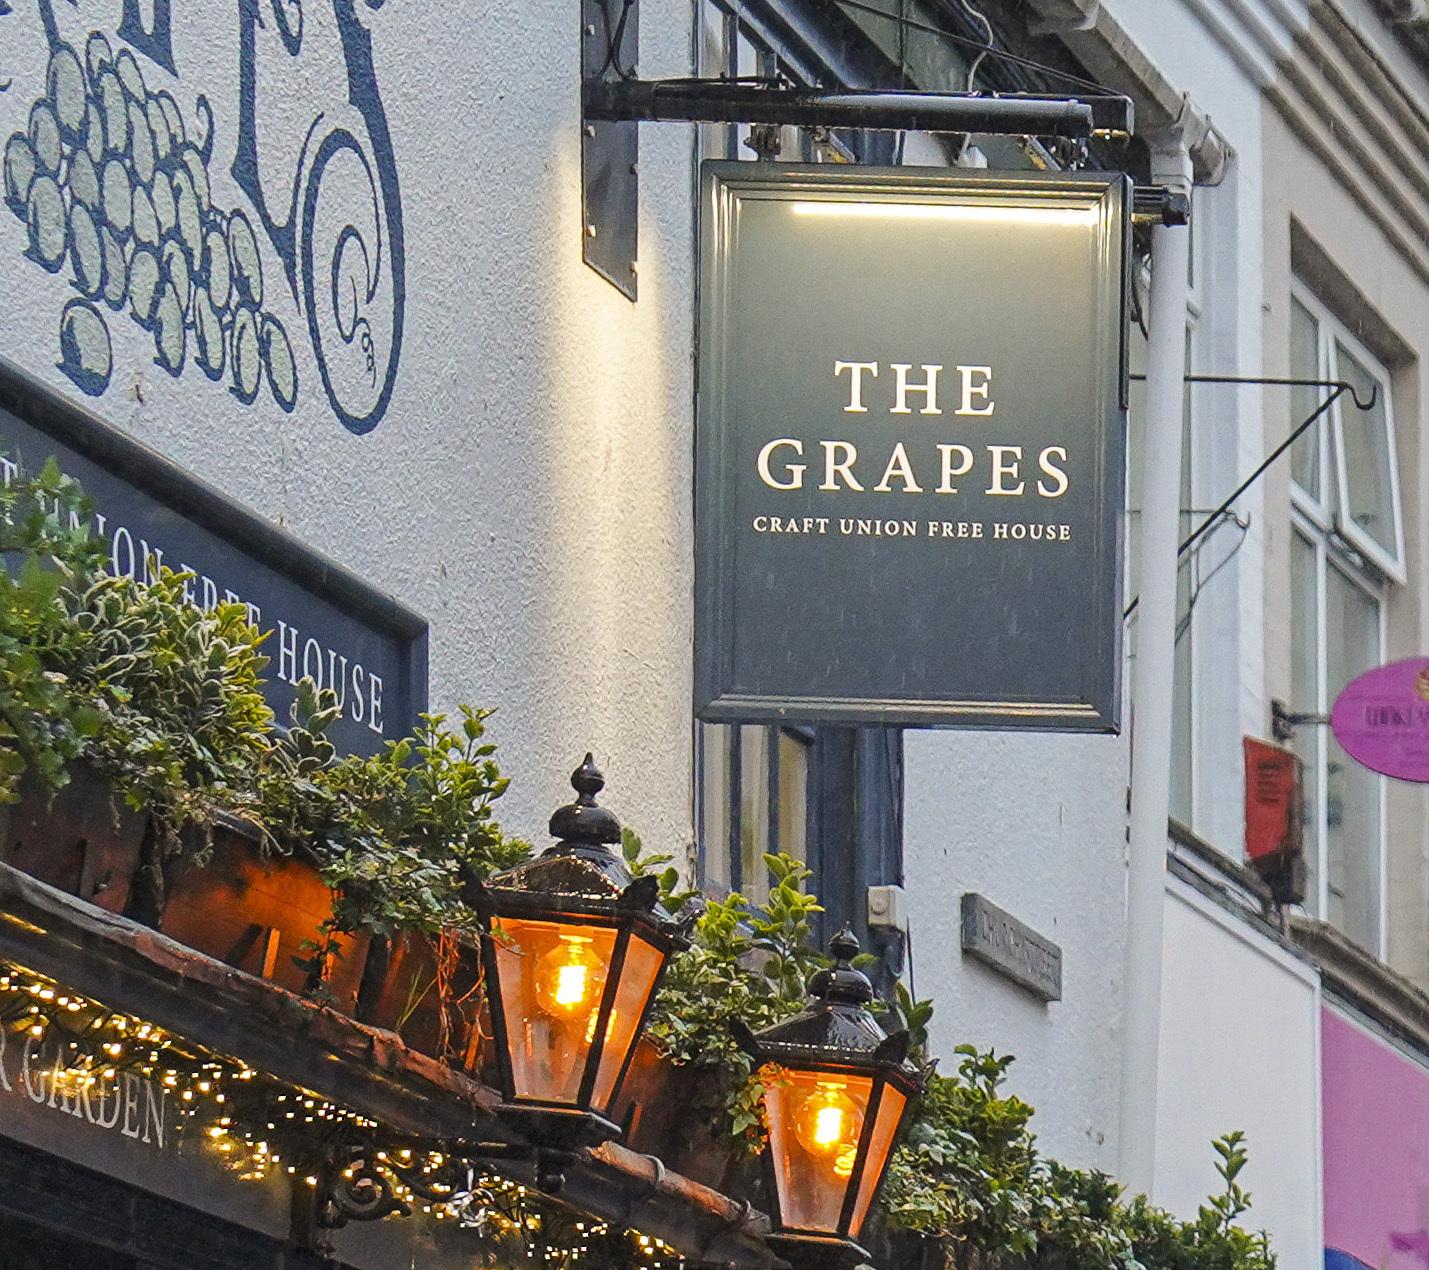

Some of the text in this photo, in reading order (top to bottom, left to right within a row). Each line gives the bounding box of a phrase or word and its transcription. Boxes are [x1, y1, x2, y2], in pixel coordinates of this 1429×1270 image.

[834, 360, 995, 416] THE
[757, 438, 1069, 498] GRAPES
[753, 516, 1071, 541] CRAFT UNION FREE HOUSE
[277, 619, 384, 735] HOUSE
[22, 1037, 166, 1148] GARDEN
